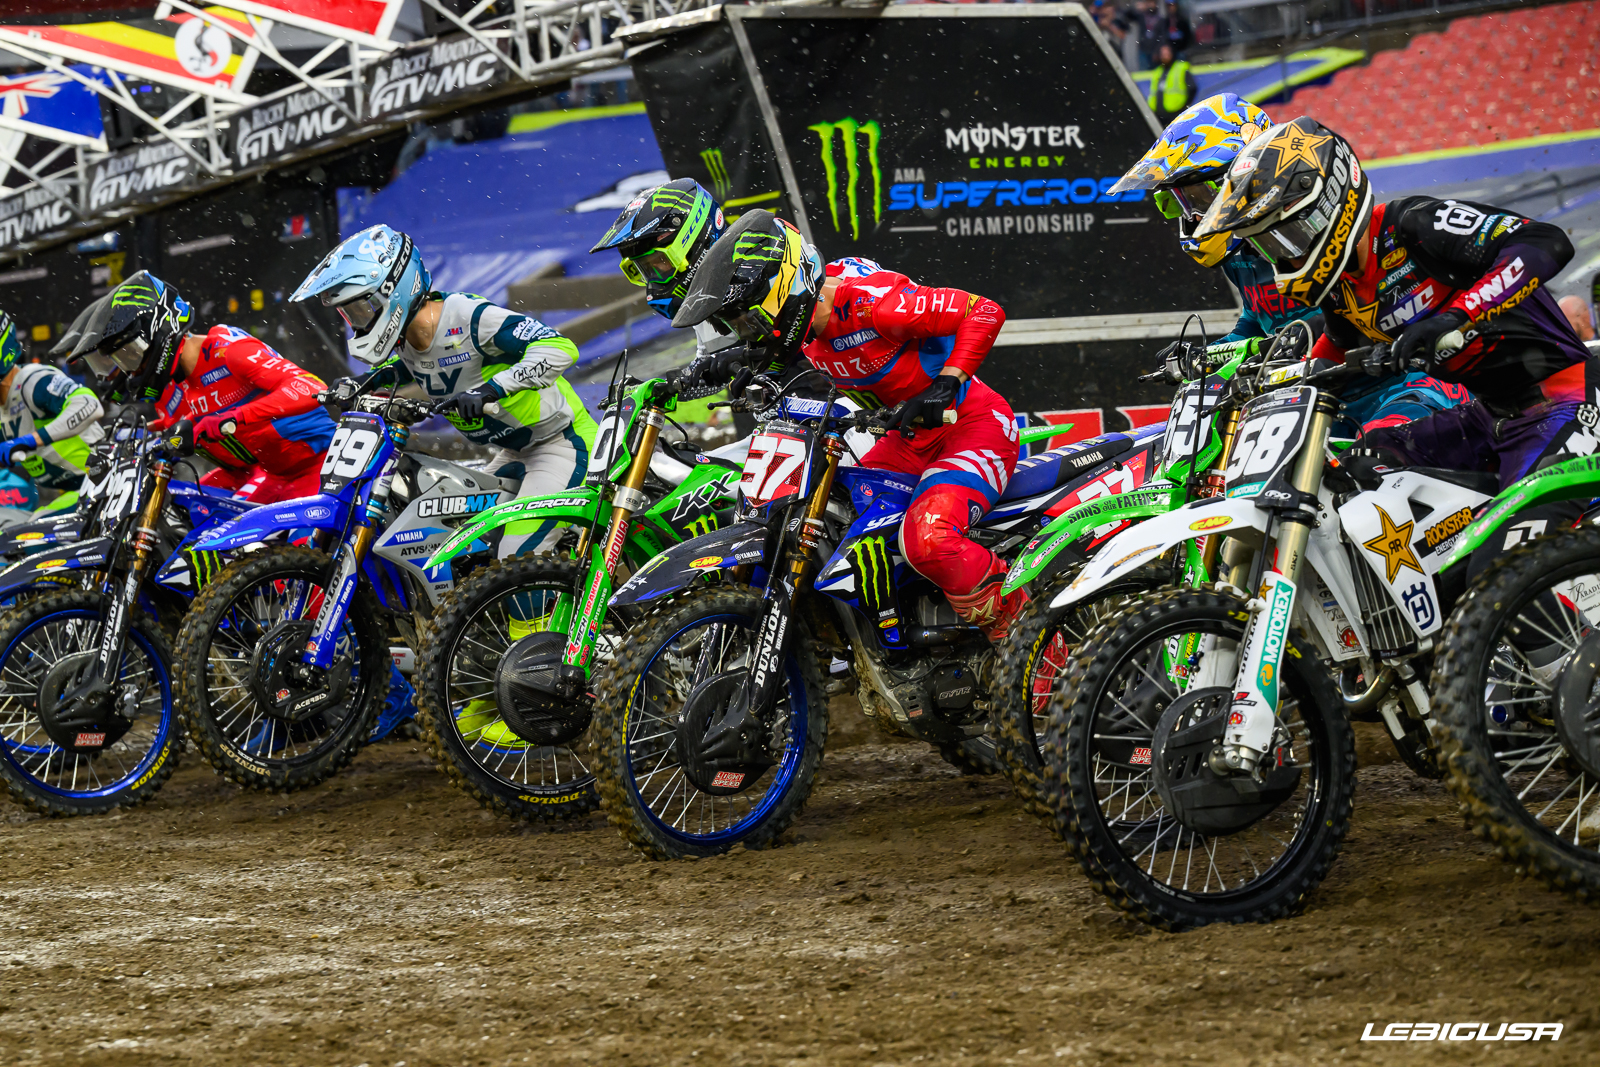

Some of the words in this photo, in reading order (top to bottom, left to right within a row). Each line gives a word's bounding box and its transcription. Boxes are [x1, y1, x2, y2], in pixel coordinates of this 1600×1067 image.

[945, 122, 1084, 154] MONSTER
[895, 168, 925, 183] AMA
[970, 156, 1065, 168] ENERGY
[888, 176, 1147, 211] SUPERCROSS
[681, 195, 708, 248] SCOT
[947, 213, 1094, 237] CHAMPIONSHIP
[1312, 189, 1358, 284] ROCKSTAR
[444, 326, 463, 337] AMA
[784, 303, 806, 346] MONSTER
[843, 328, 879, 348] YAMAHA
[444, 352, 471, 366] YAMAHA
[205, 367, 231, 383] YAMAHA
[413, 367, 463, 396] FLY
[1024, 425, 1056, 435] DUNLOP
[320, 428, 378, 478] 89
[1069, 451, 1104, 468] YAMAHA
[1226, 412, 1300, 482] 58
[742, 434, 806, 500] 37
[1094, 466, 1109, 476] DAVIES
[672, 471, 735, 522] KX
[1234, 483, 1261, 496] MOTOREX
[418, 491, 500, 519] CLUBMX
[525, 498, 591, 511] CIRCUIT
[1067, 503, 1101, 524] SONS
[1102, 504, 1116, 513] OUR
[395, 531, 424, 543] YAMAHA
[1189, 516, 1233, 531] FMF
[1425, 506, 1474, 546] ROCKSTAR
[606, 519, 629, 574] SHOWA
[740, 549, 761, 560] YAMAHA
[1436, 538, 1455, 555] ENERGY
[690, 556, 723, 567] FMF
[315, 566, 343, 633] DUNLOP
[584, 570, 603, 616] BRAKING
[593, 588, 608, 621] PISTONS
[775, 615, 788, 651] BRAKING
[1263, 590, 1292, 663] MOTOREX
[755, 600, 780, 688] DUNLOP
[1240, 612, 1260, 676] DUNLO
[1022, 629, 1045, 702] DUNLOP
[294, 692, 327, 711] ACERBIS
[939, 686, 972, 700] GYTR
[621, 675, 641, 746] DUNLOP
[131, 748, 170, 790] DUNLOP
[220, 743, 268, 777] DUNLOP
[518, 791, 581, 804] DUNLOP
[713, 780, 741, 788] SPEED
